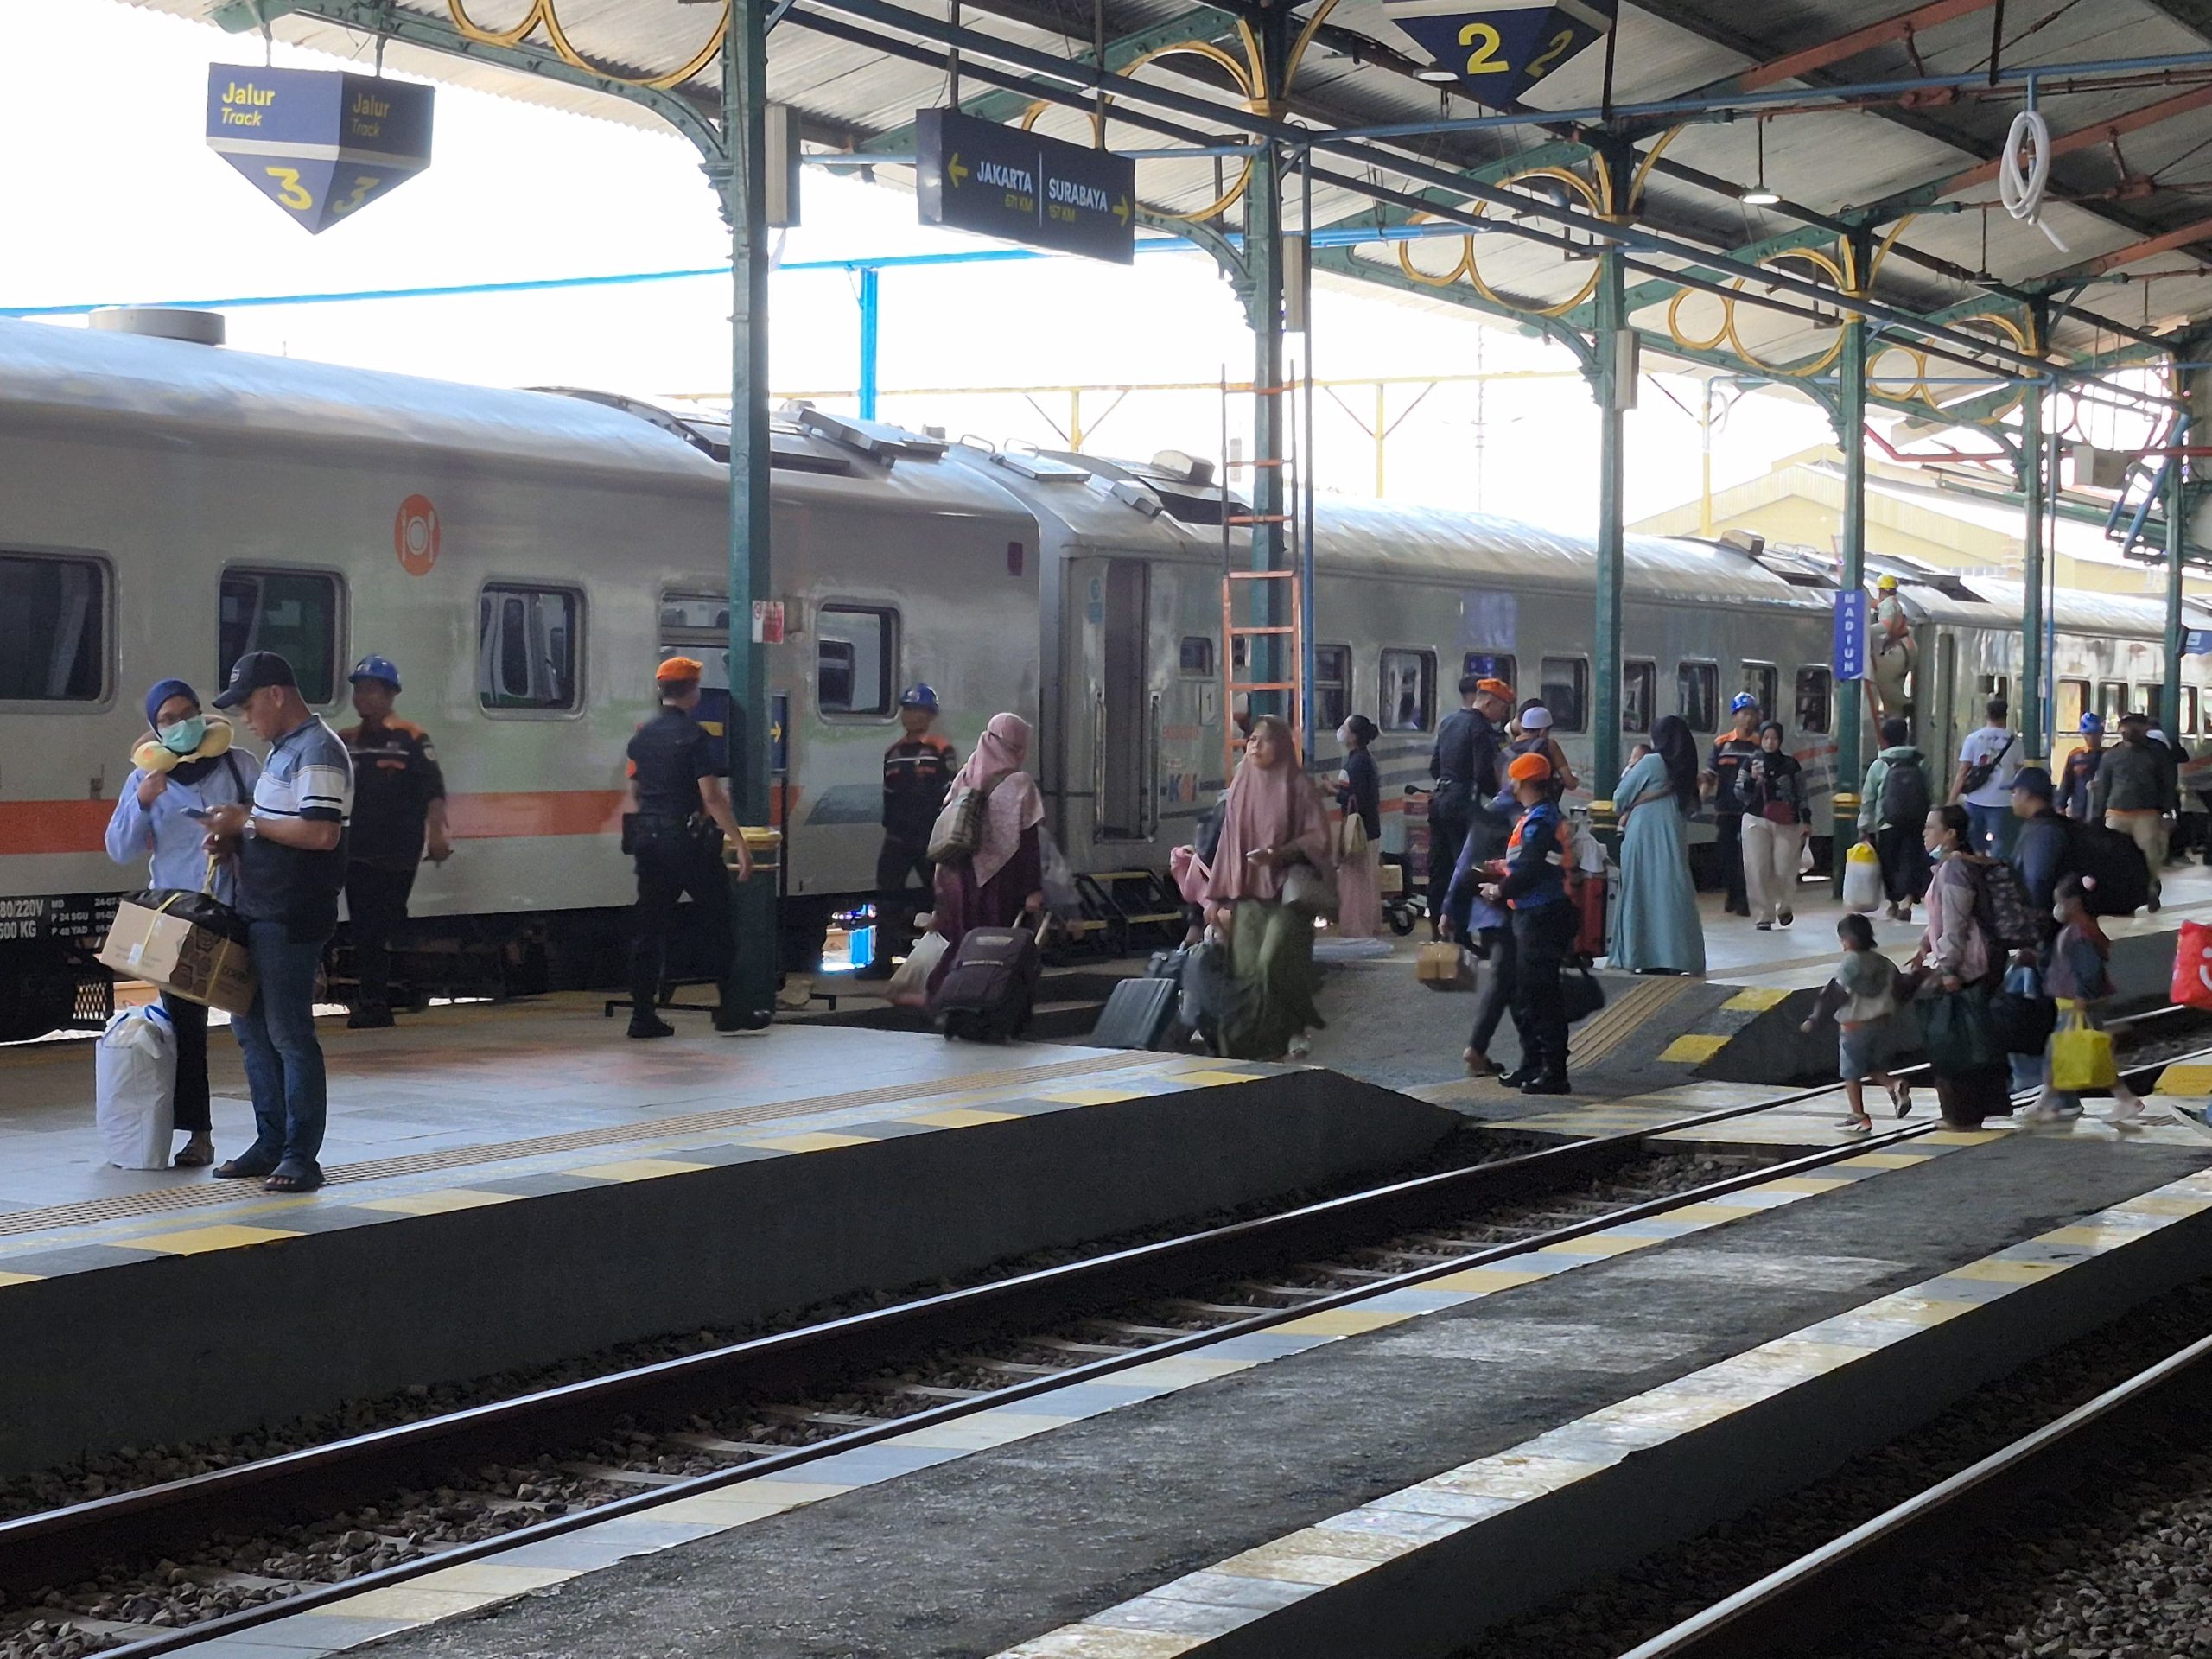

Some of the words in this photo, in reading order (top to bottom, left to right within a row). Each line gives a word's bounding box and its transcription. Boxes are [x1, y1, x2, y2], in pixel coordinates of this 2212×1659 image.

[1458, 22, 1510, 75] 2
[1524, 29, 1573, 78] 2
[221, 81, 276, 106] Jalur
[352, 92, 390, 118] Jalur
[221, 107, 263, 127] Track
[352, 118, 381, 137] Track
[264, 166, 313, 211] 3
[976, 161, 1033, 194] JAKARTA
[332, 175, 381, 213] 3
[1019, 196, 1033, 213] KM
[1048, 177, 1108, 213] SURABAYA
[1062, 207, 1076, 223] KM
[1844, 594, 1855, 672] MADIUN
[20, 920, 37, 938] KG
[51, 913, 57, 923] P
[71, 912, 89, 921] SGU
[51, 926, 58, 936] P
[70, 925, 88, 935] YAD
